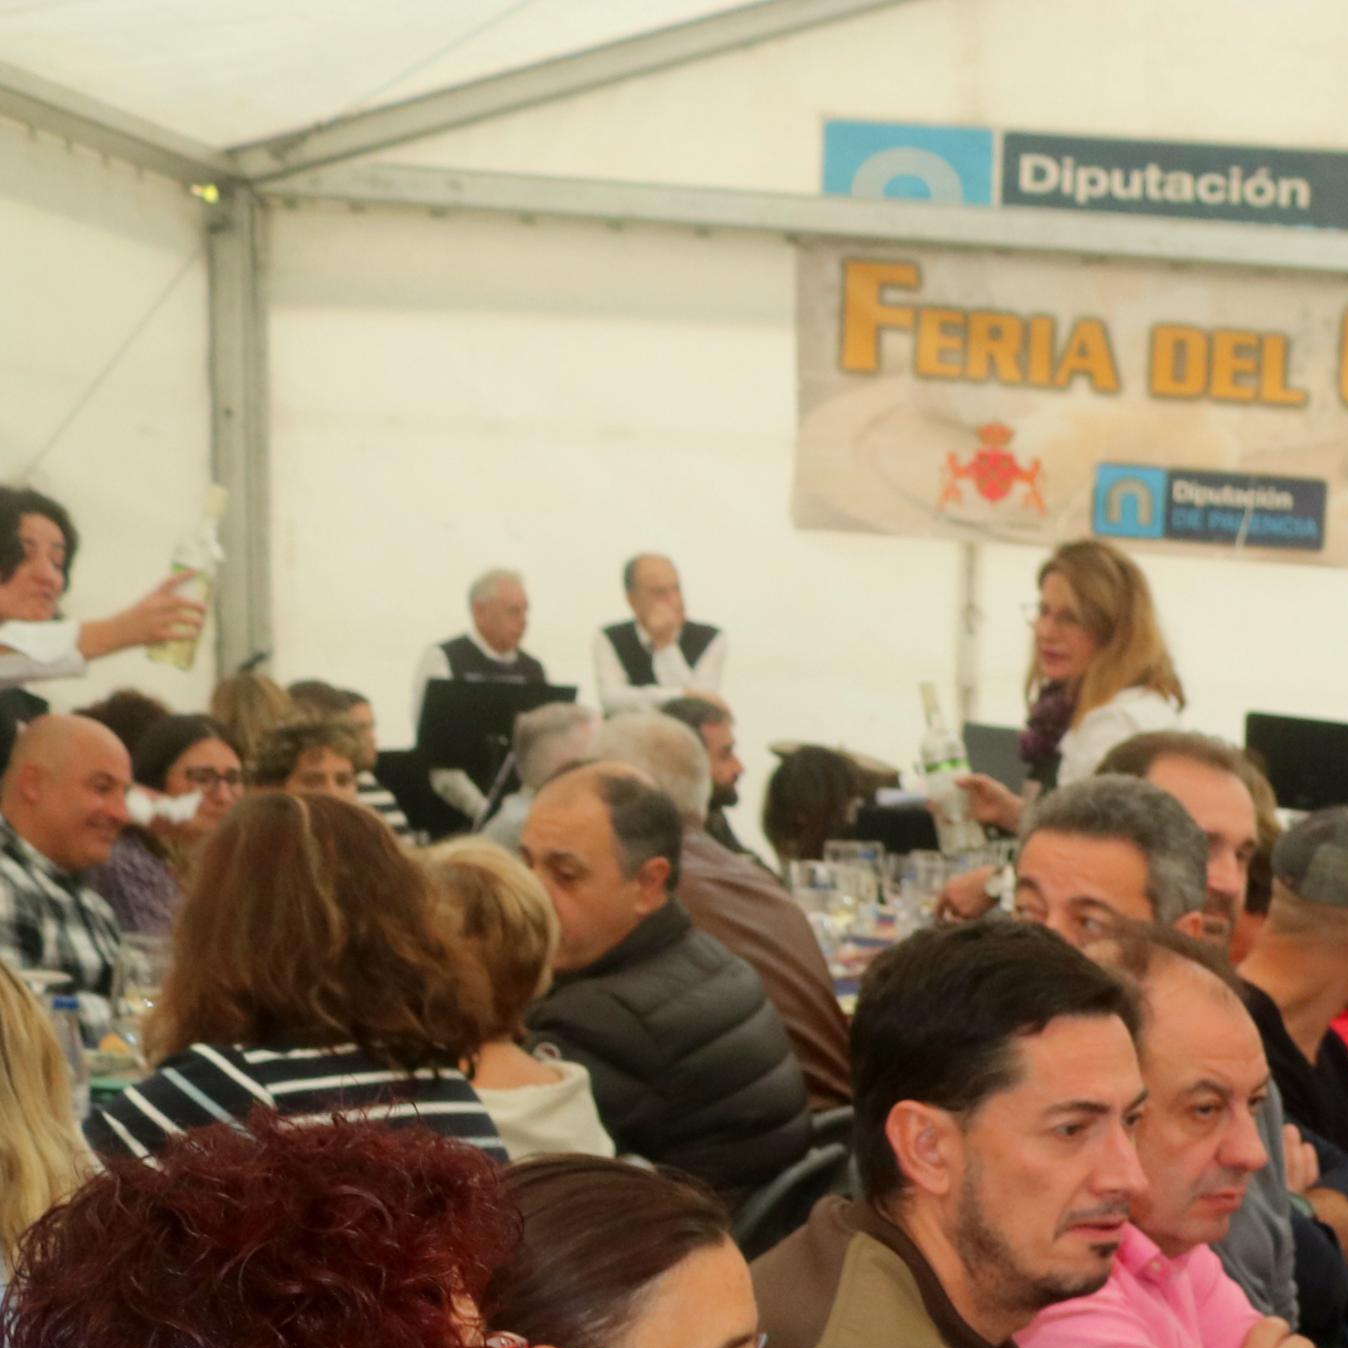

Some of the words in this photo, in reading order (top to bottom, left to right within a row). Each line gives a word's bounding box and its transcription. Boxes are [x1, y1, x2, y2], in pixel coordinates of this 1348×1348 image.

[1018, 152, 1312, 211] Diputación
[1148, 320, 1308, 408] DEL
[1171, 478, 1295, 511] Diputación
